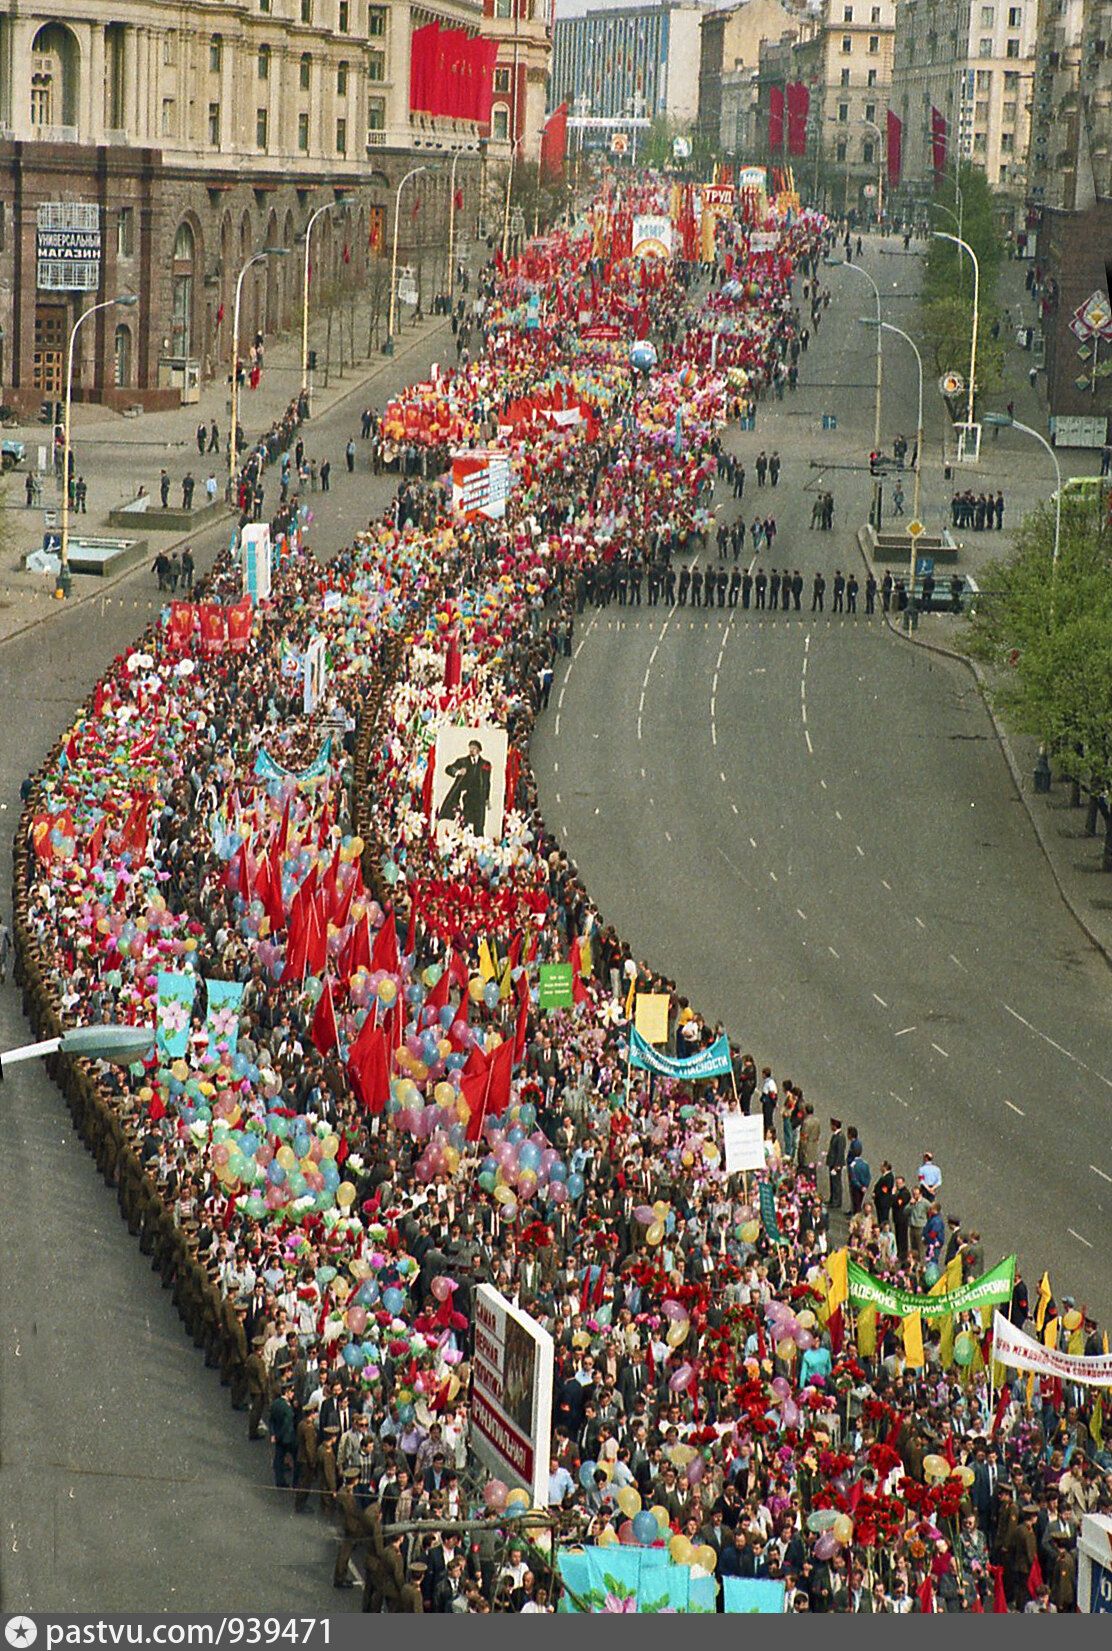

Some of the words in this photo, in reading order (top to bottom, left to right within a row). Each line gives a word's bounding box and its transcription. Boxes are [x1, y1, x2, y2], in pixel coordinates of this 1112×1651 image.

[705, 189, 732, 203] ТРУД
[638, 224, 665, 238] МИР
[38, 233, 101, 248] УНИВЕРСАЛЬНЫЙ
[38, 248, 101, 259] МАГАЗИН
